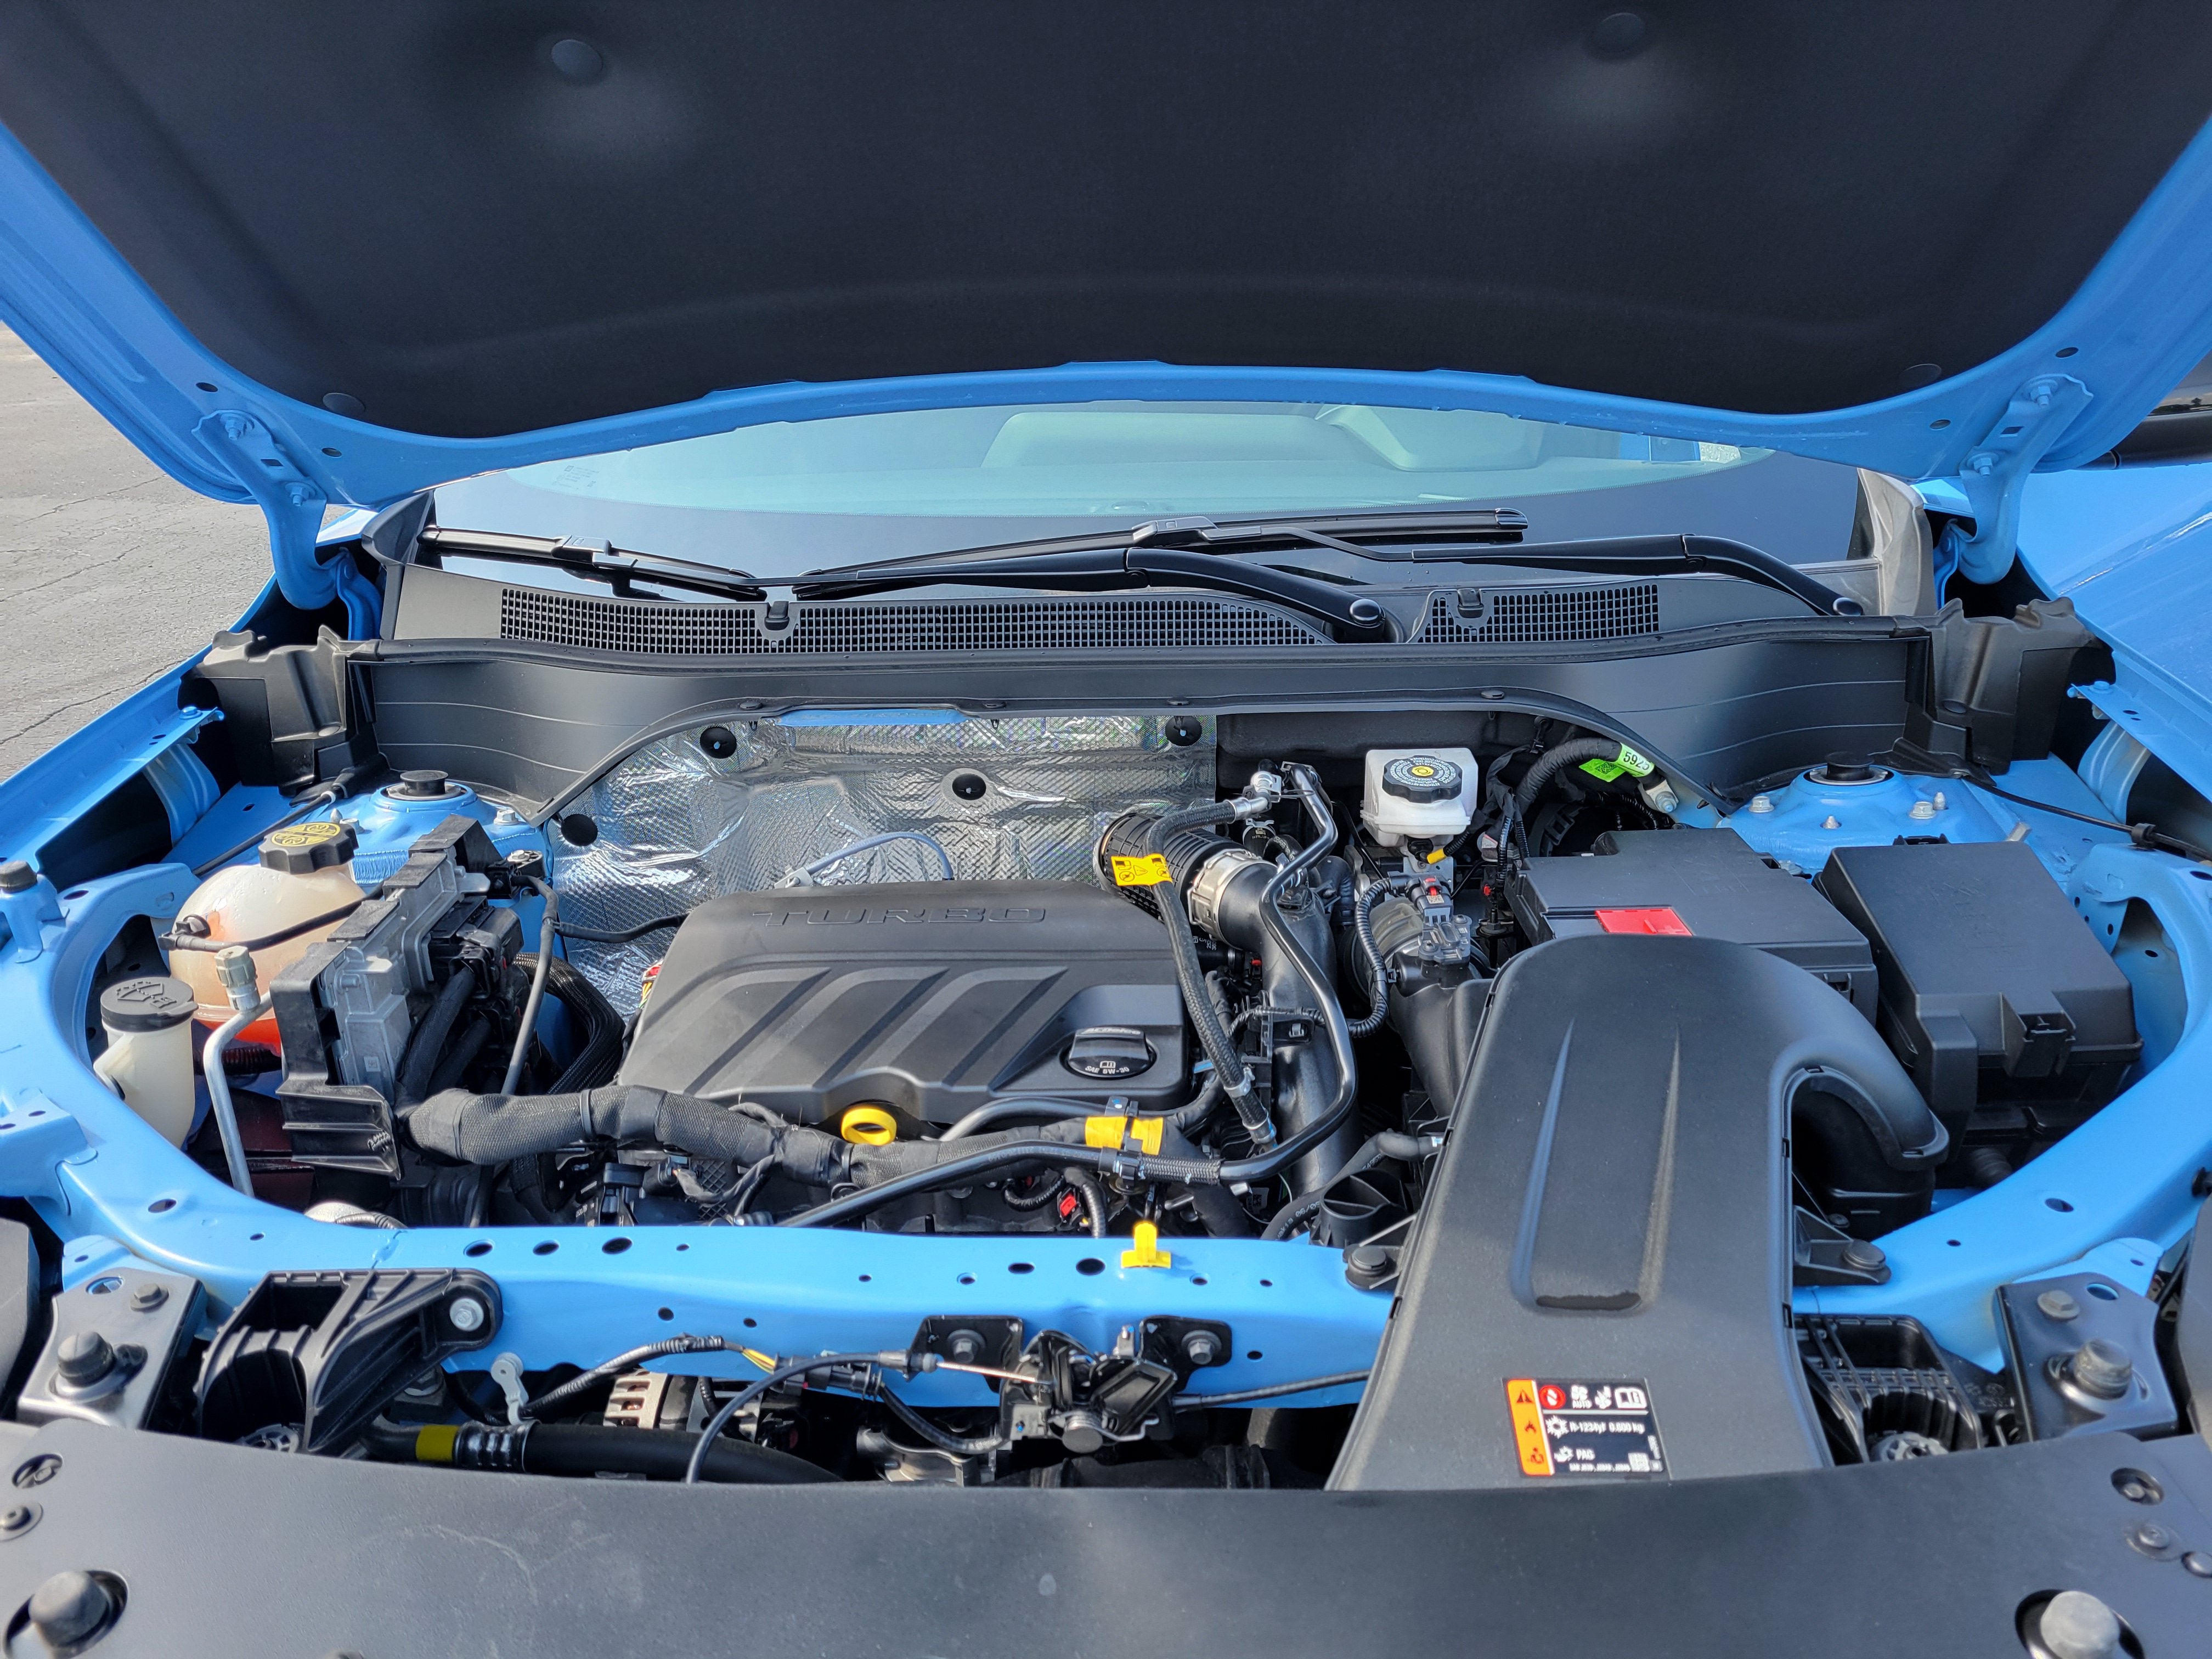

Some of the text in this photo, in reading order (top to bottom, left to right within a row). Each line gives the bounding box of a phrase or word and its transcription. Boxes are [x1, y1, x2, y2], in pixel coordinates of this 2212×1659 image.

[752, 907, 1046, 927] TURBO
[1085, 1065, 1100, 1074] SAE
[1572, 1401, 1592, 1409] AUTO
[1576, 1448, 1595, 1461] PAG
